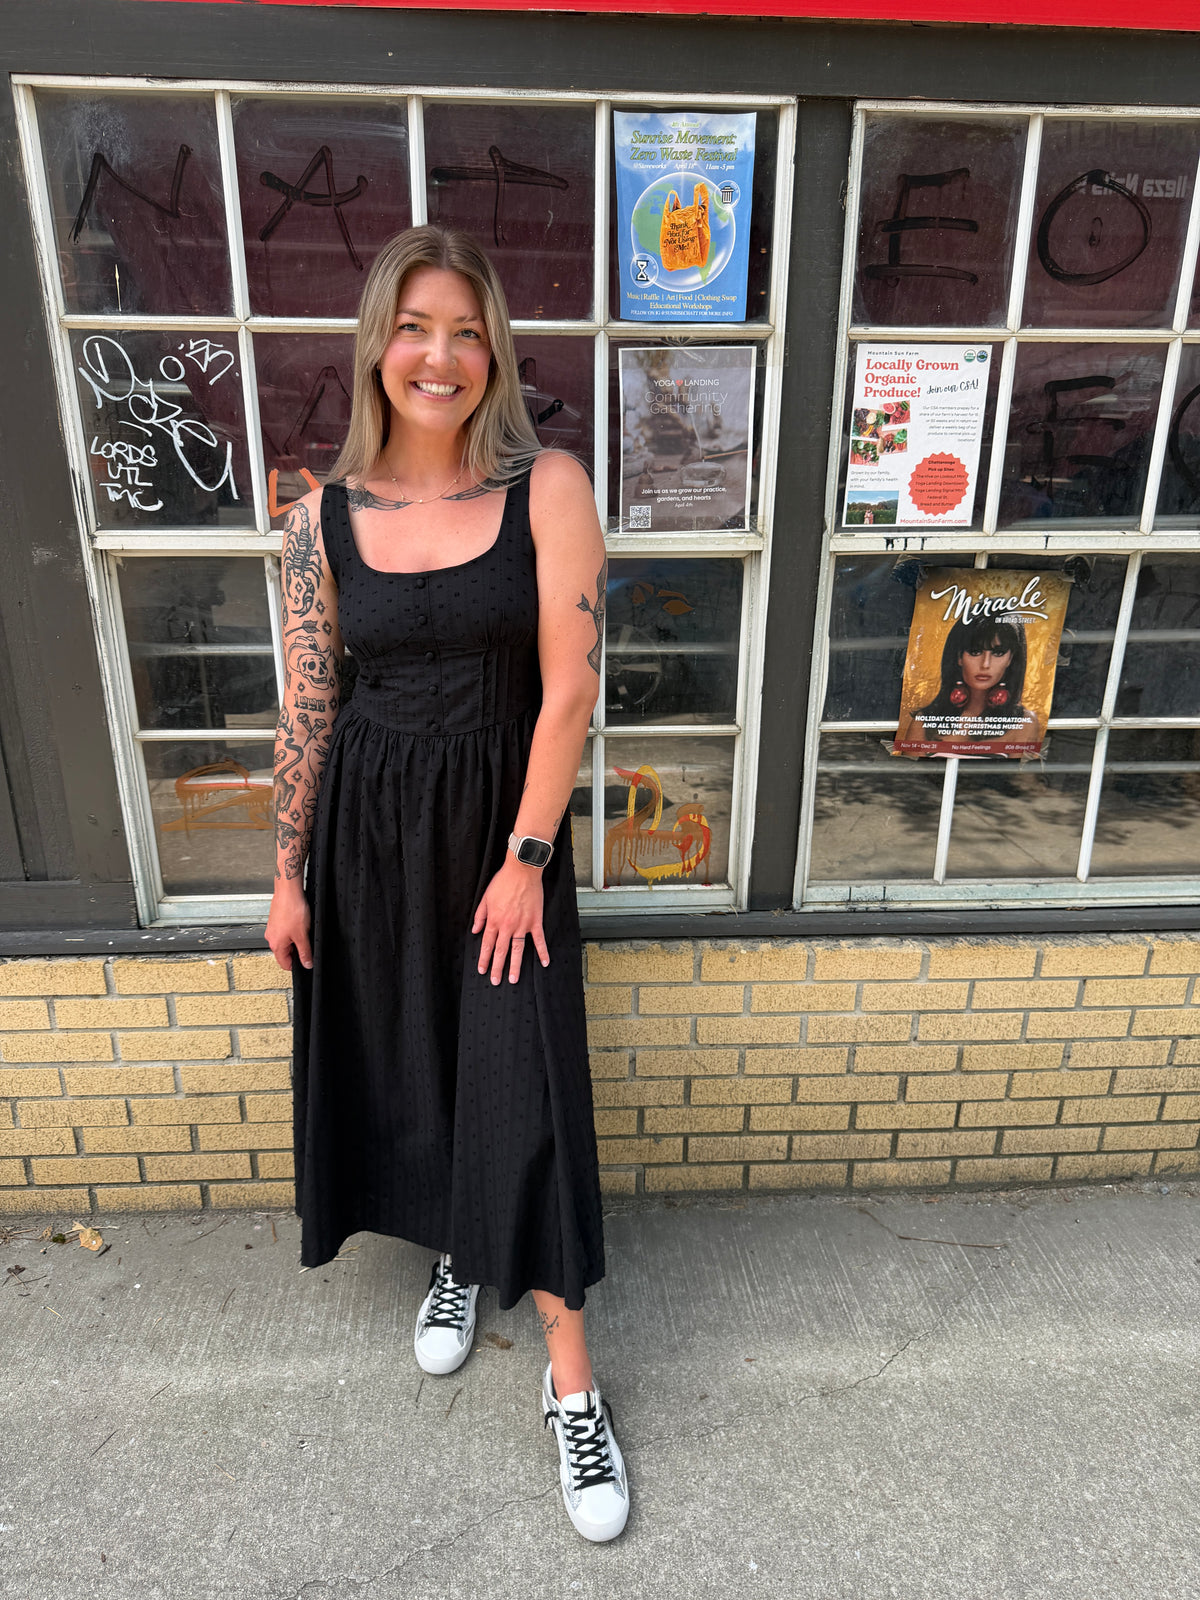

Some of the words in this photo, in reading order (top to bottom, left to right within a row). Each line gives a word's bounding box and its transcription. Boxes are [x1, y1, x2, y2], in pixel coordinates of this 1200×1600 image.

[631, 130, 674, 145] Sunrise
[630, 147, 657, 161] Zero
[660, 147, 694, 161] Waste
[695, 147, 739, 162] Festival
[674, 163, 688, 171] April
[670, 221, 691, 231] Thank
[678, 293, 693, 301] Food
[697, 294, 721, 303] Clothing
[721, 294, 738, 303] Swap
[649, 302, 682, 310] Educational
[682, 302, 713, 311] Workshops
[866, 358, 913, 372] Locally
[915, 359, 960, 371] Grown
[653, 379, 676, 387] YOGA
[684, 378, 720, 387] LANDING
[864, 372, 917, 386] Organic
[863, 387, 922, 398] Produce!
[927, 385, 943, 395] Join
[943, 384, 959, 393] our
[959, 378, 980, 392] CSA!
[644, 391, 729, 404] Community
[649, 402, 722, 417] Gathering
[91, 436, 158, 467] LORDS
[678, 488, 692, 497] grow
[703, 486, 728, 494] practice,
[656, 495, 681, 503] gardens,
[930, 576, 1047, 625] Miracle
